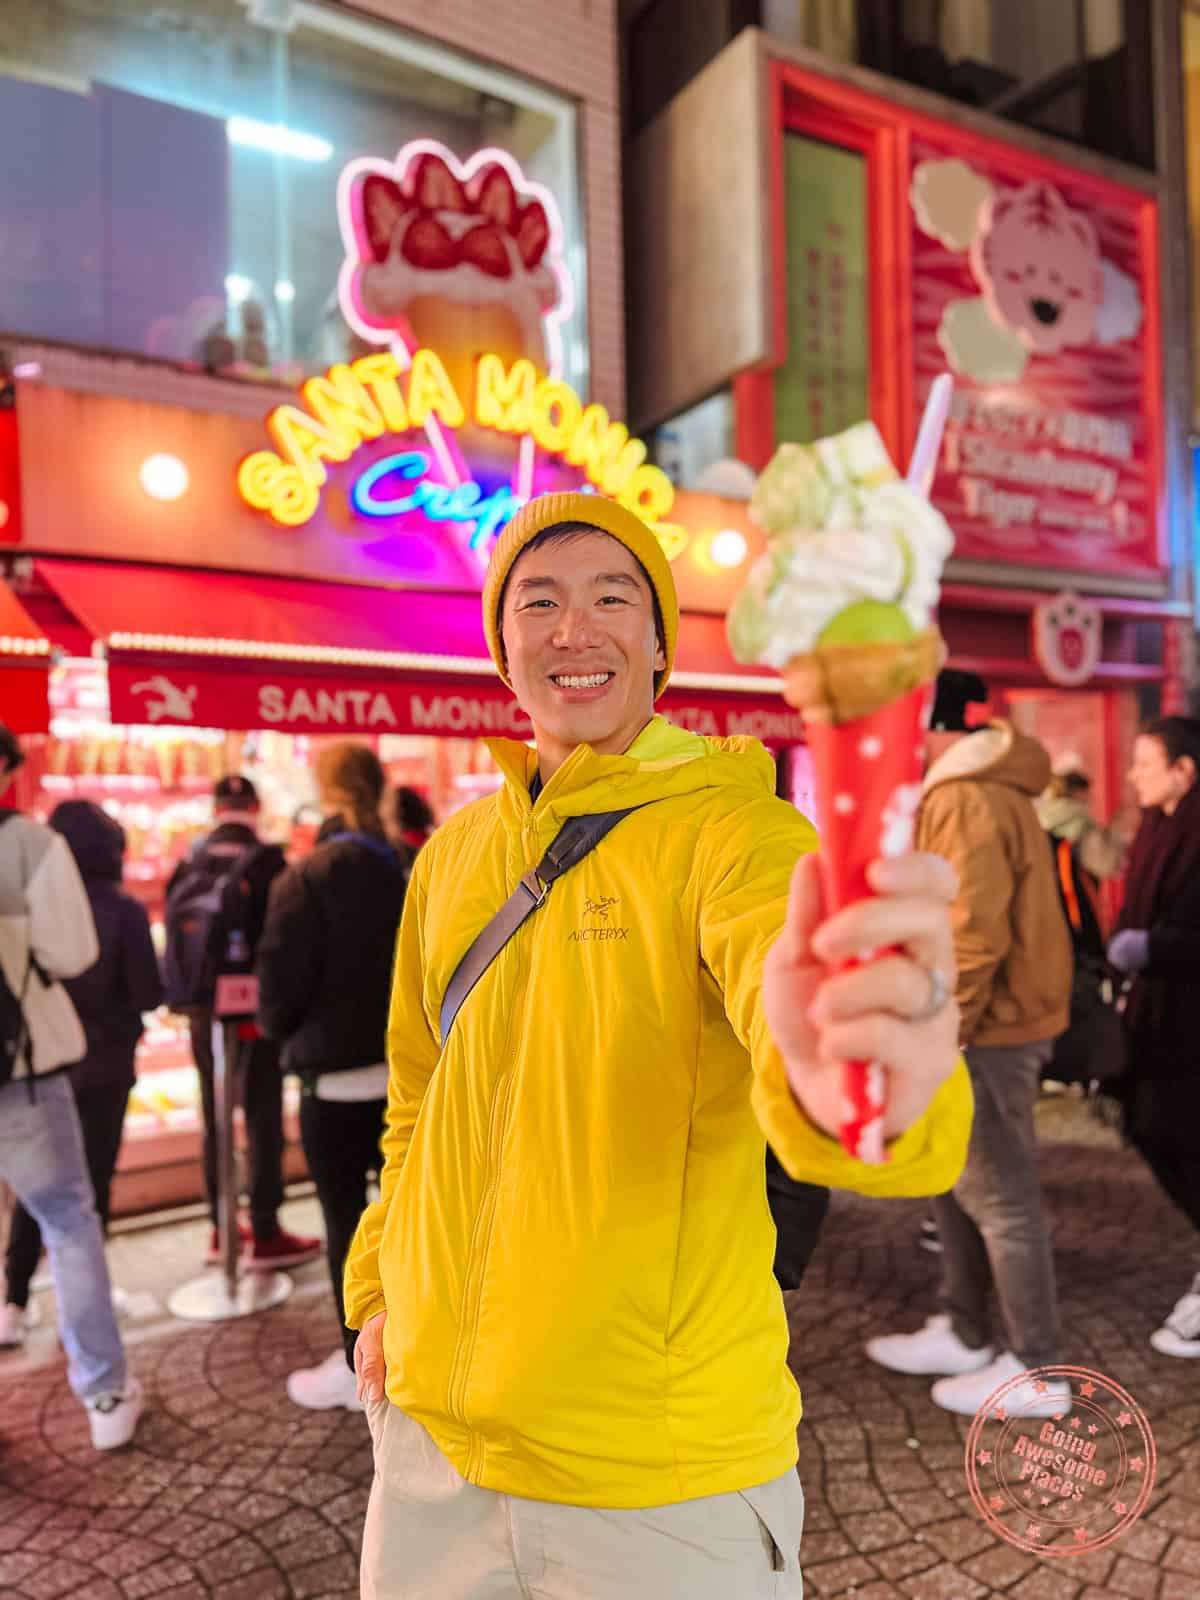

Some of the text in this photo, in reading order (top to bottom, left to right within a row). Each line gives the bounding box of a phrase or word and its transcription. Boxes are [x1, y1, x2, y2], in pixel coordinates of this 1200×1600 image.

[238, 349, 462, 525] SANTA
[257, 685, 533, 732] SANTA MONIC
